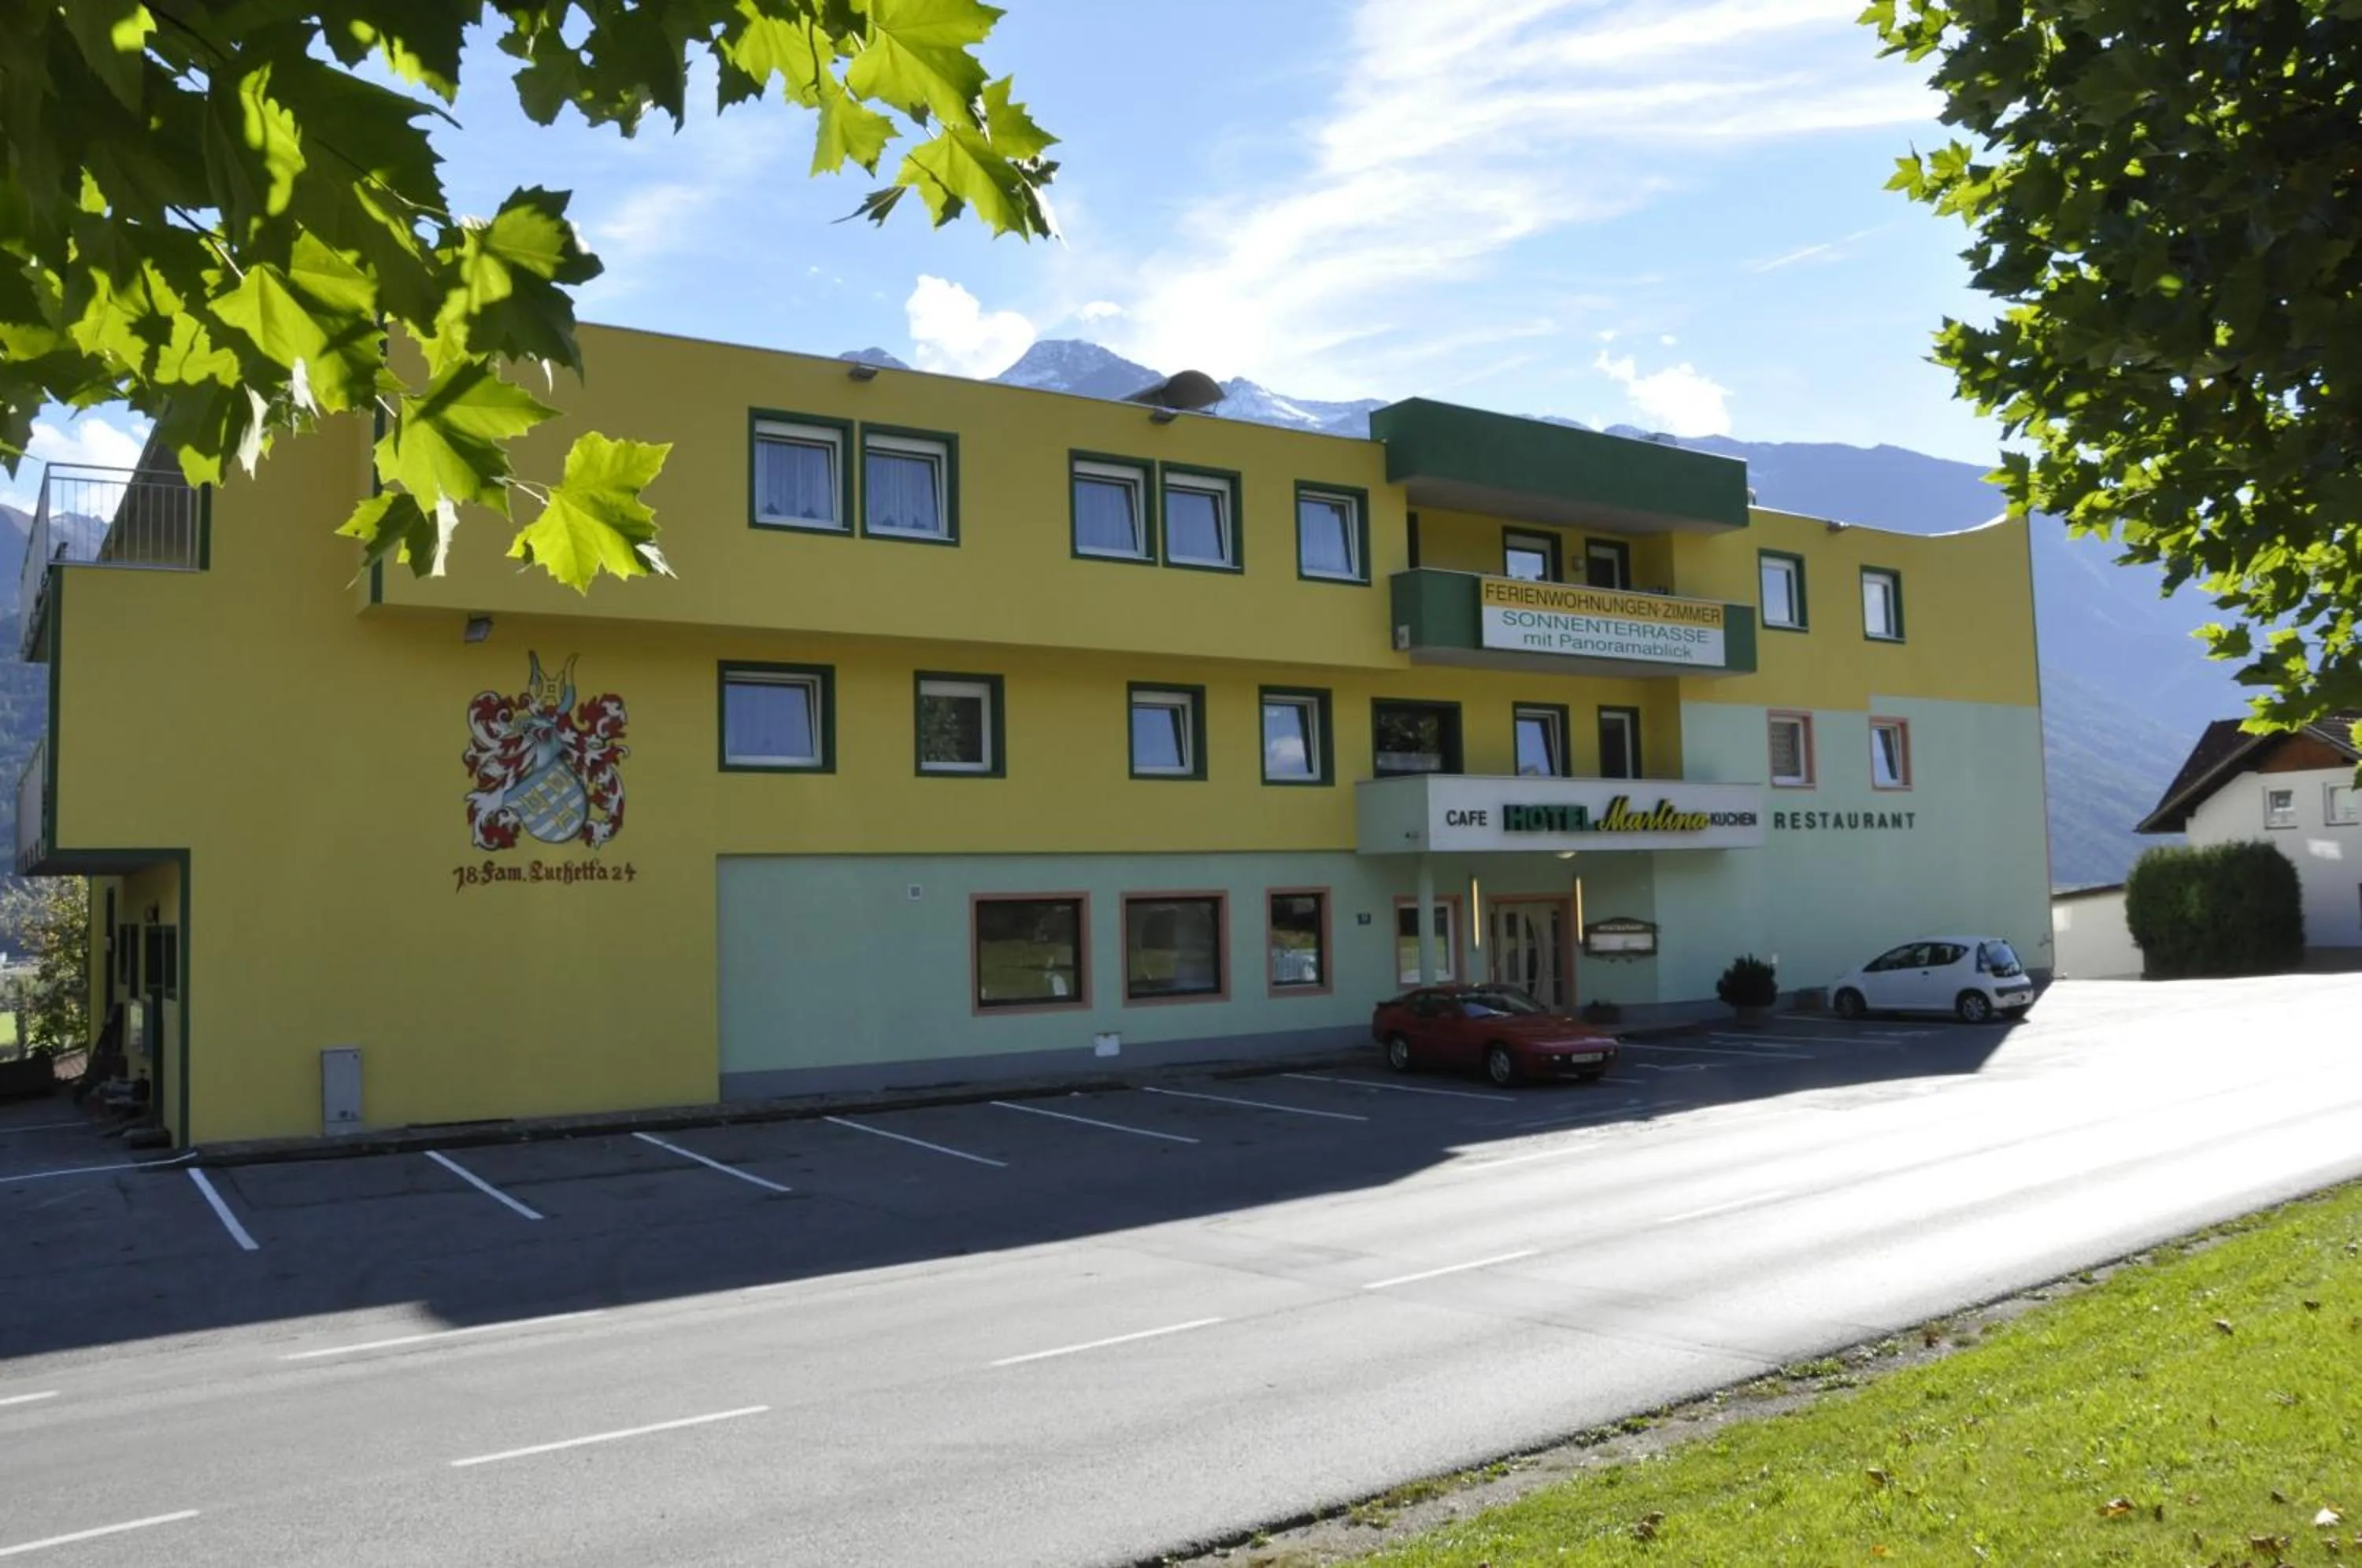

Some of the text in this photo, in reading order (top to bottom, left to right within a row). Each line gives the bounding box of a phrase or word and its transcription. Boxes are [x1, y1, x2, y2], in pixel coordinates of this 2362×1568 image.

[1502, 610, 1710, 643] SONNENTERRASSE
[1524, 632, 1692, 658] mit Panoramablick
[1446, 810, 1487, 827] CAFE
[1503, 804, 1596, 831] HOTEL
[1595, 795, 1710, 831] Martina
[1774, 812, 1916, 829] RESTAURANT
[479, 860, 527, 886] Fam.
[612, 863, 636, 882] 24
